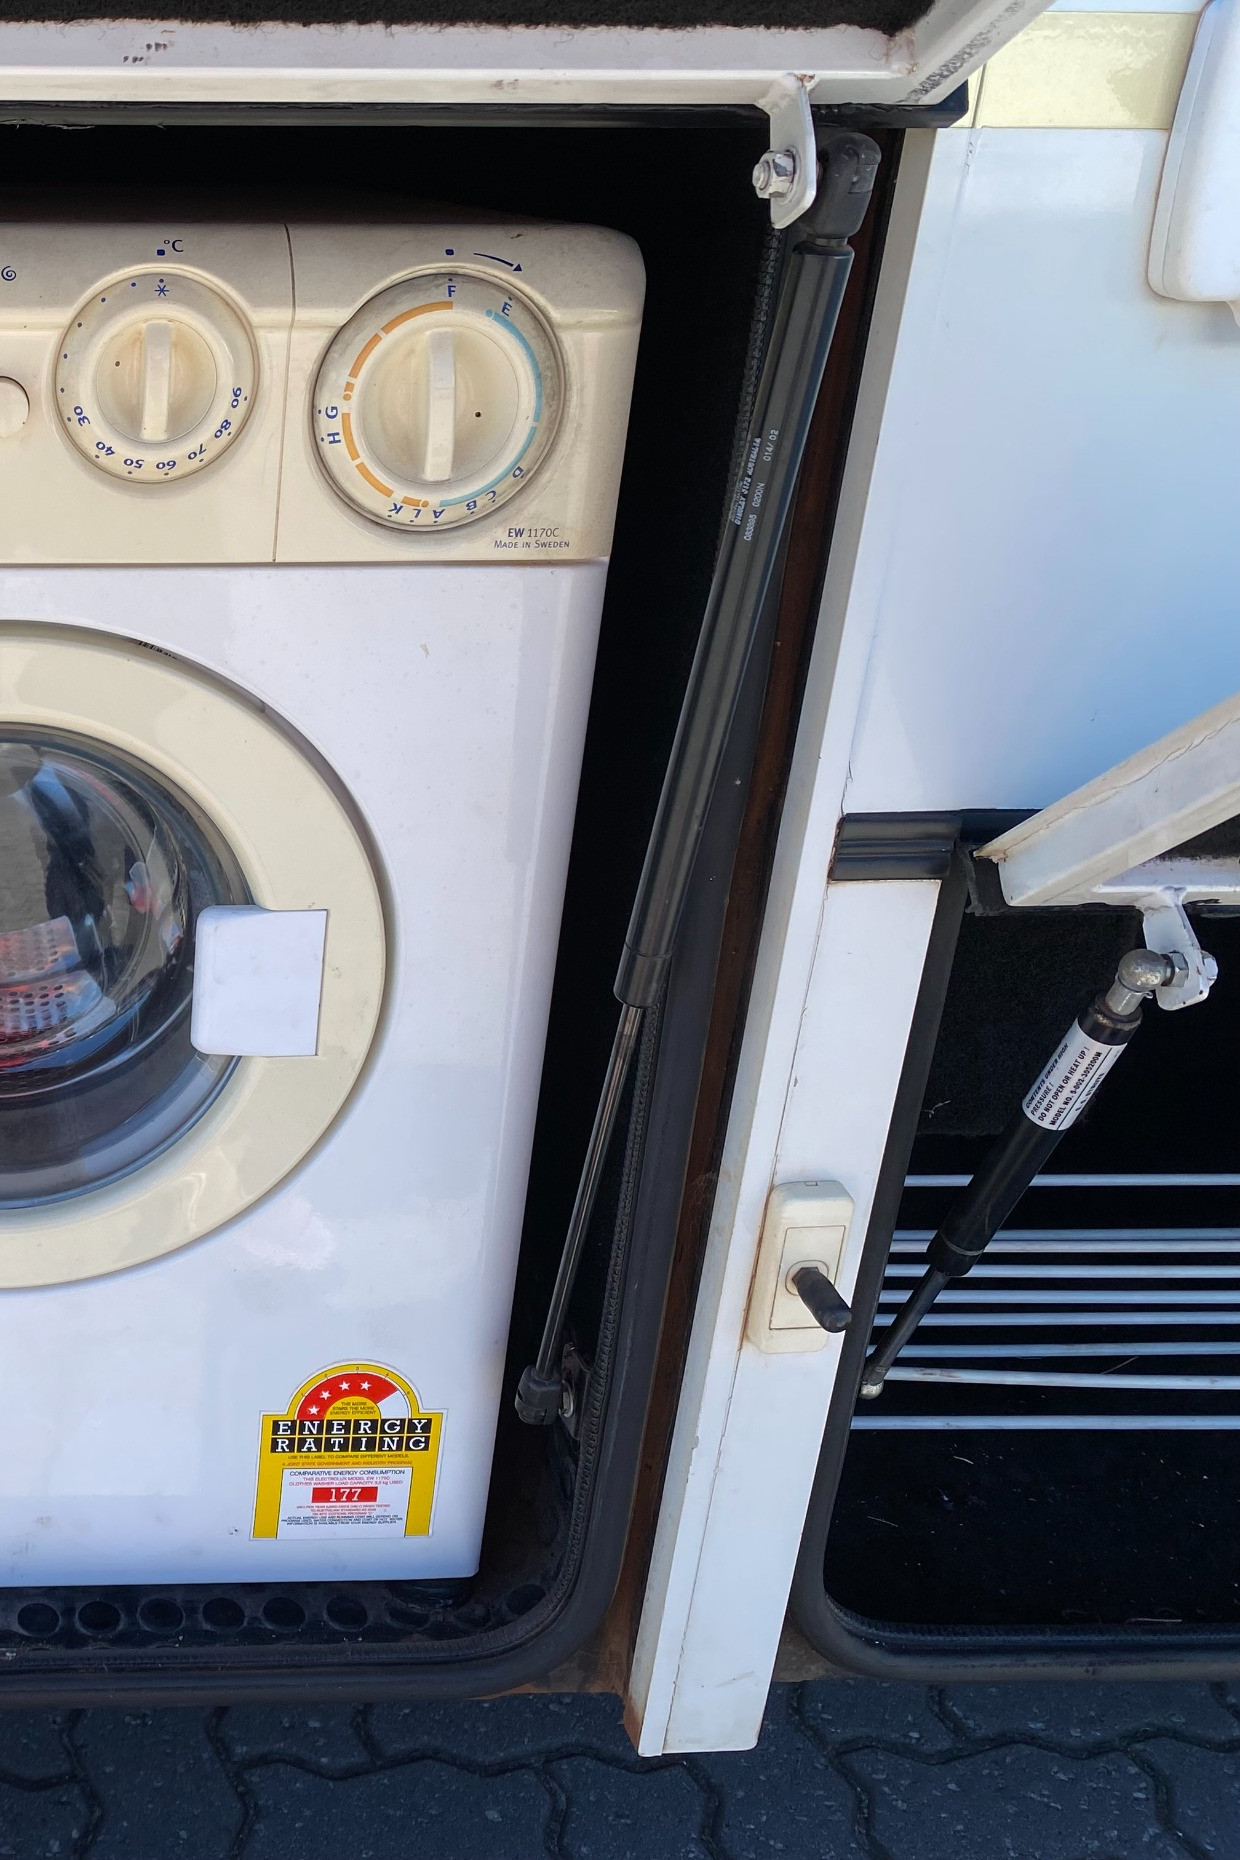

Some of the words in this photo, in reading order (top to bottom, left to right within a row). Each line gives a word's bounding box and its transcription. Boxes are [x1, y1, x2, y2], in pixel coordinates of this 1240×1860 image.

[164, 239, 184, 252] °C
[447, 285, 456, 297] F
[501, 301, 512, 317] E
[231, 387, 241, 408] 90
[73, 406, 91, 426] 30
[325, 406, 338, 419] G
[214, 419, 231, 438] 80
[327, 432, 341, 445] H
[96, 441, 115, 456] 40
[187, 443, 206, 460] 70
[124, 458, 144, 469] 50
[156, 460, 176, 470] 60
[512, 466, 524, 478] D
[485, 490, 497, 501] C
[388, 503, 404, 514] K
[466, 500, 477, 511] B
[413, 508, 421, 518] L
[432, 508, 445, 518] A
[508, 528, 525, 537] EW
[527, 528, 559, 537] 1170C
[1038, 1112, 1046, 1121] DO
[1045, 1100, 1054, 1113] NOT
[1052, 1084, 1064, 1100] OPEN
[1062, 1075, 1071, 1085] OR
[1068, 1059, 1081, 1076] HEAT
[1078, 1050, 1087, 1060] UP
[1049, 1106, 1066, 1126] MODEL
[277, 1420, 427, 1434] ENERGY
[276, 1437, 425, 1452] RATING
[329, 1488, 362, 1501] 177
